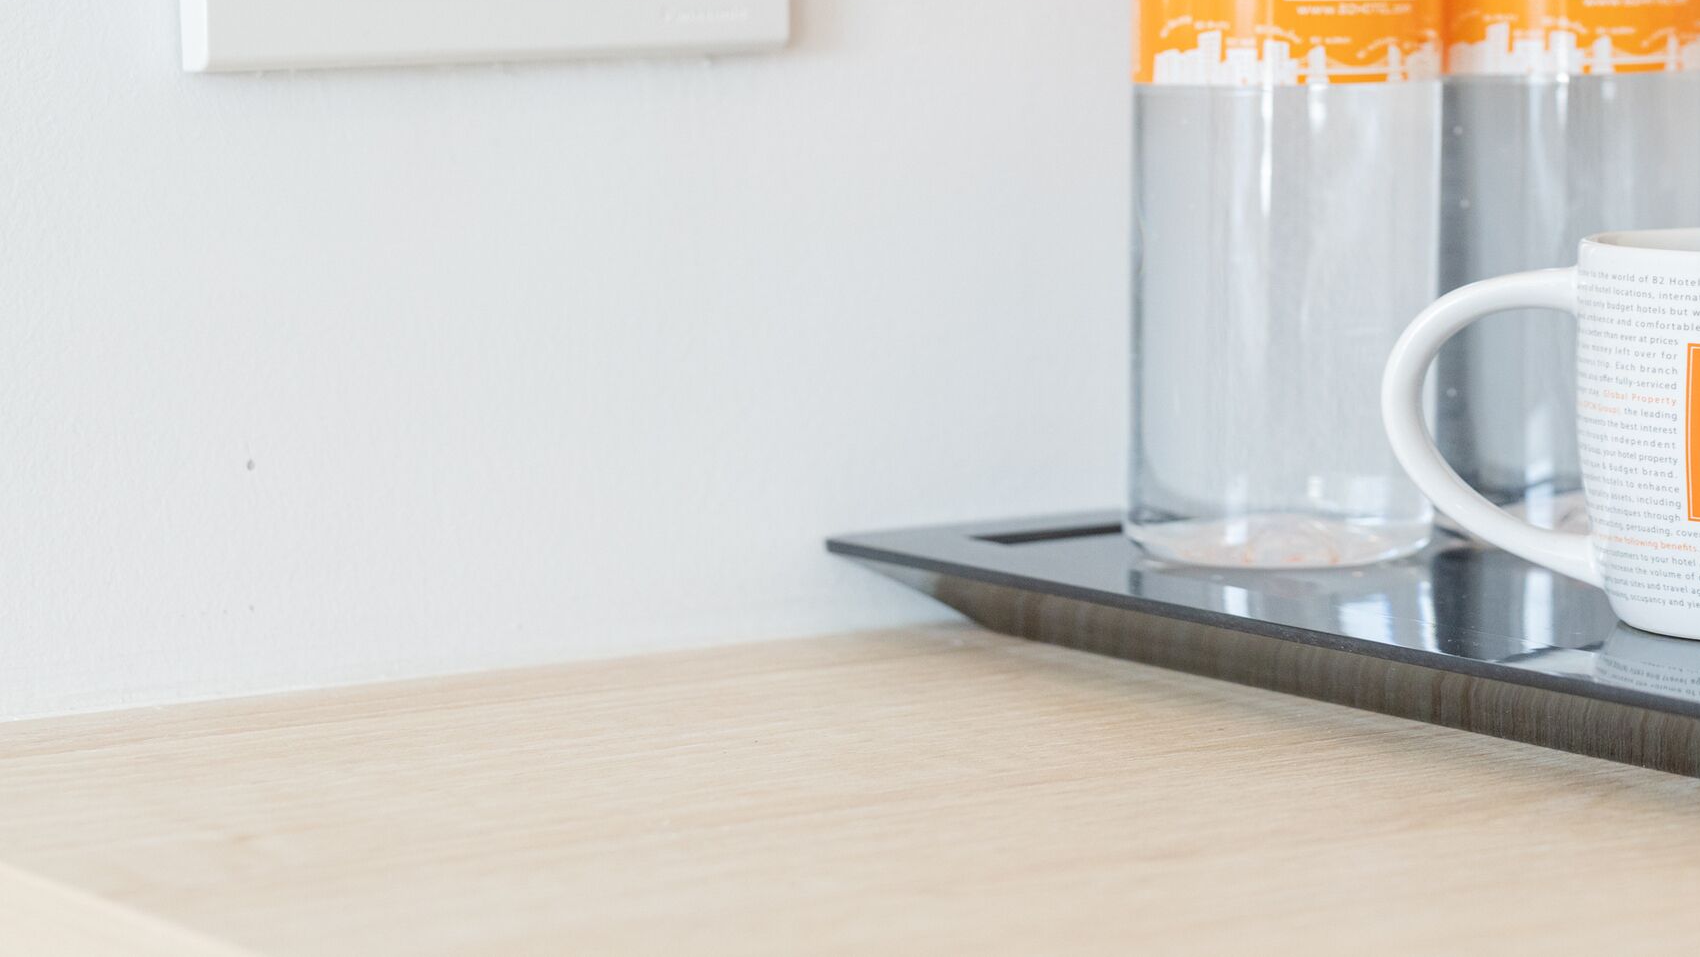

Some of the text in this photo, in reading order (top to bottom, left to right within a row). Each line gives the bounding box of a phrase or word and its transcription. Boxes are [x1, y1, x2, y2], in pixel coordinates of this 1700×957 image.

[1638, 274, 1649, 283] of
[1652, 275, 1665, 284] B2
[1636, 304, 1666, 315] hotels
[1669, 306, 1688, 316] but
[1649, 336, 1679, 346] prices
[1634, 350, 1678, 360] over for
[1615, 361, 1678, 375] Each branch
[1631, 393, 1677, 407] Property
[1640, 422, 1677, 435] interest
[1638, 482, 1680, 493] enhance
[1662, 582, 1688, 594] travel
